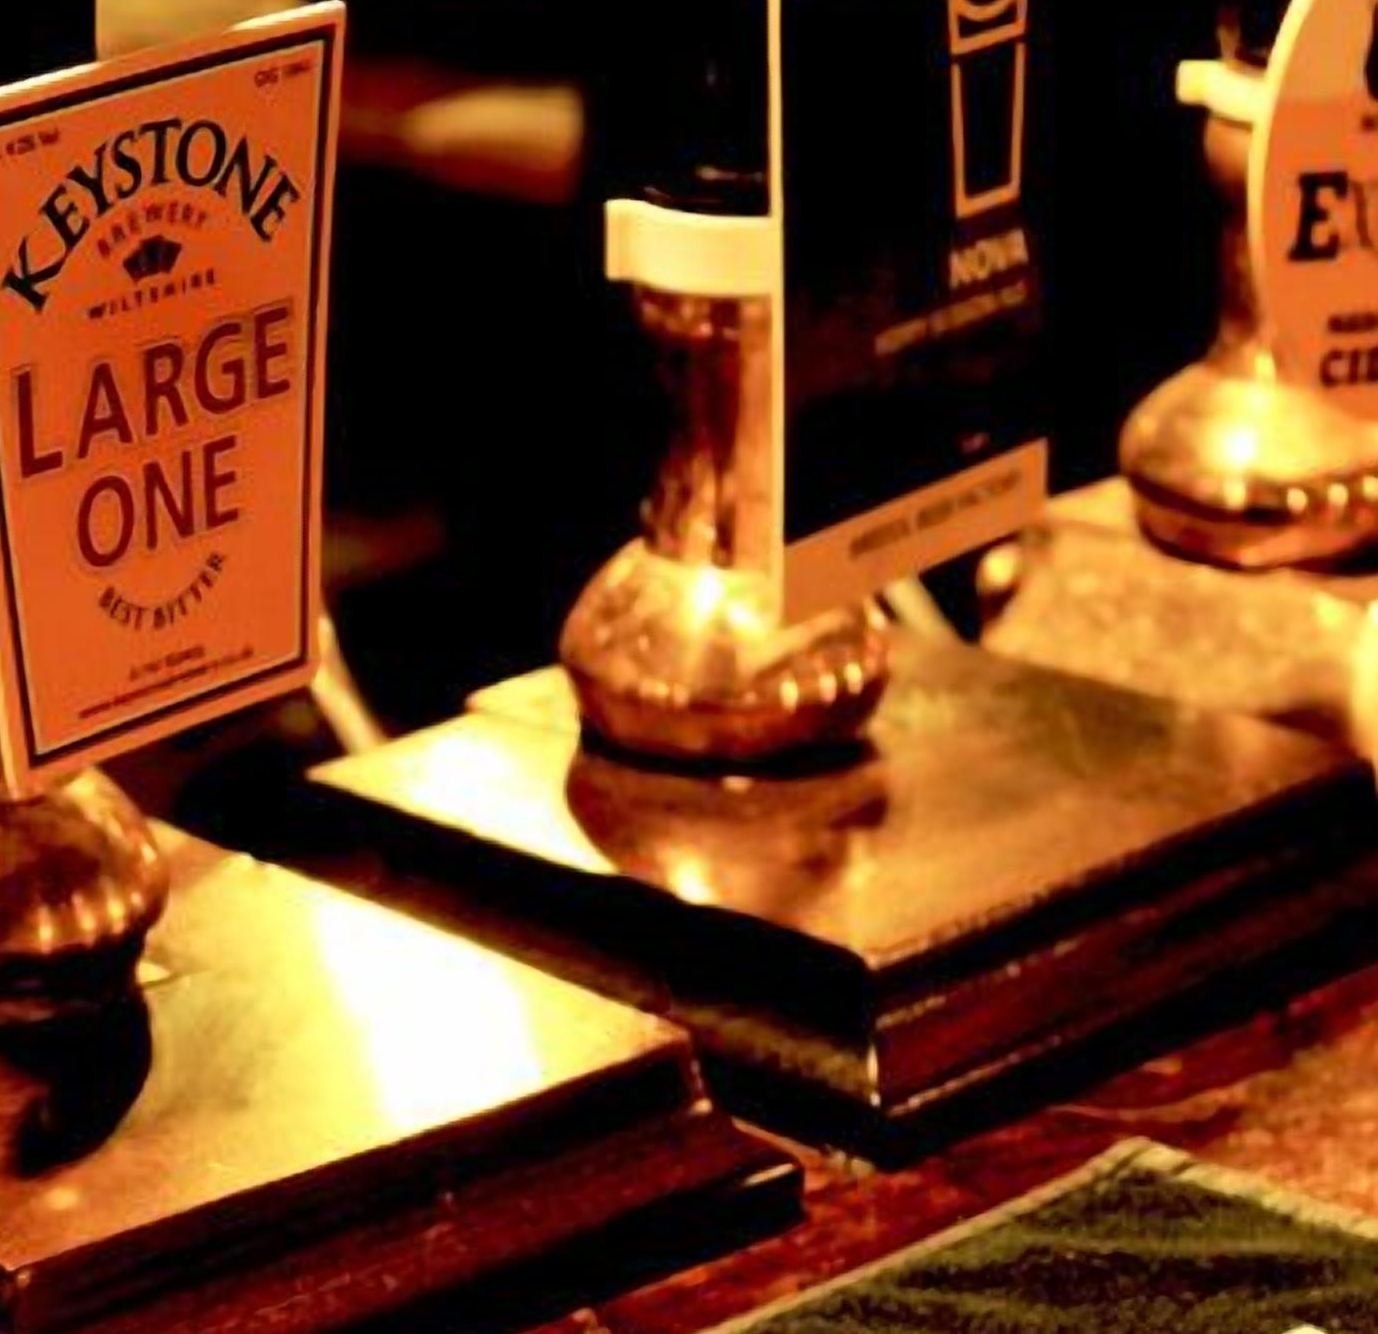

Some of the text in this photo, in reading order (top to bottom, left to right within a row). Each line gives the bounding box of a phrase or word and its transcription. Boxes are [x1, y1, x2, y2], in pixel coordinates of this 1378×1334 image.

[0, 117, 301, 313] KEYSTONE
[97, 199, 208, 259] BREWERY
[87, 267, 215, 319] WILTSHIRE
[17, 304, 292, 478] LARGE
[76, 434, 240, 568] ONE
[98, 552, 225, 632] BEST BITTER
